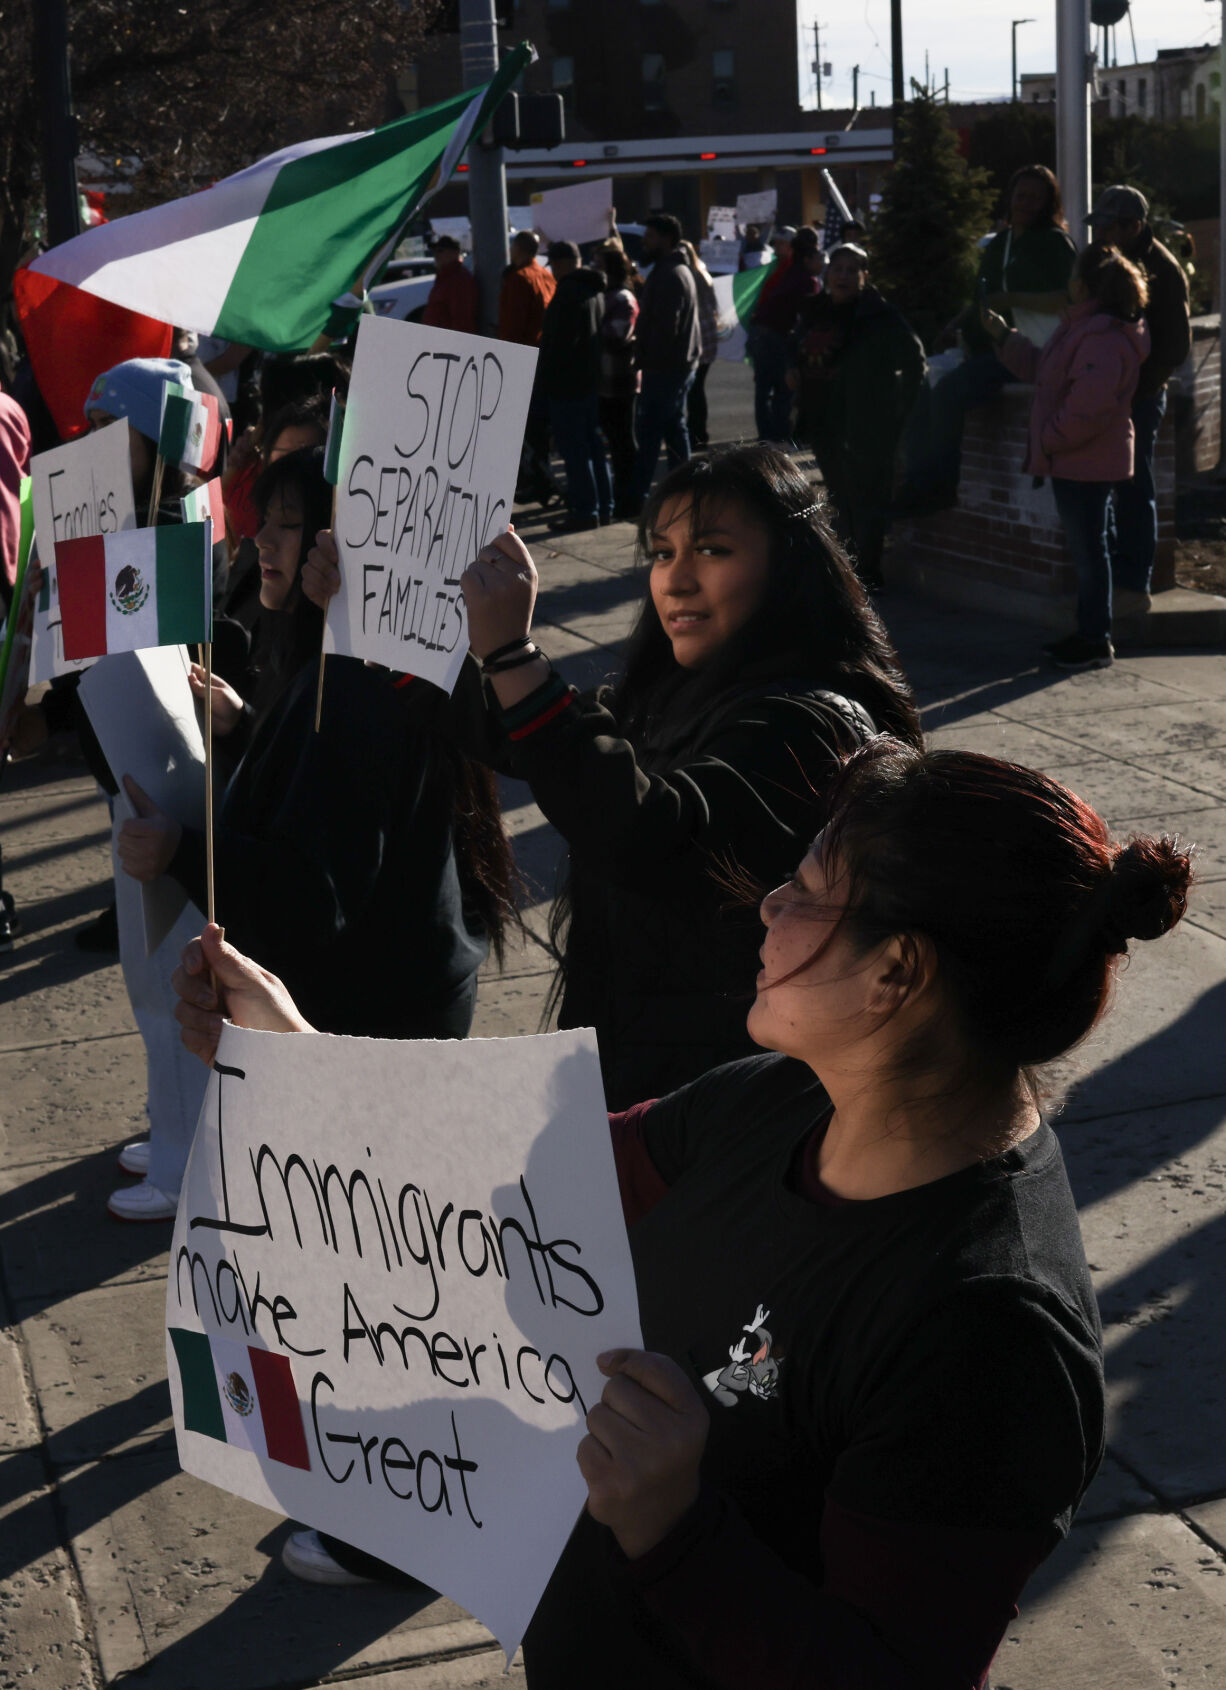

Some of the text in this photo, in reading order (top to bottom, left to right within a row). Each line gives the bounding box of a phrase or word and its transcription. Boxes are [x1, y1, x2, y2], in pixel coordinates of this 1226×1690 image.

[395, 351, 504, 484] STOP
[362, 563, 467, 654] FAMILIES
[189, 1061, 605, 1321] Immigrants
[177, 1245, 588, 1416] make America
[310, 1371, 484, 1530] Great
